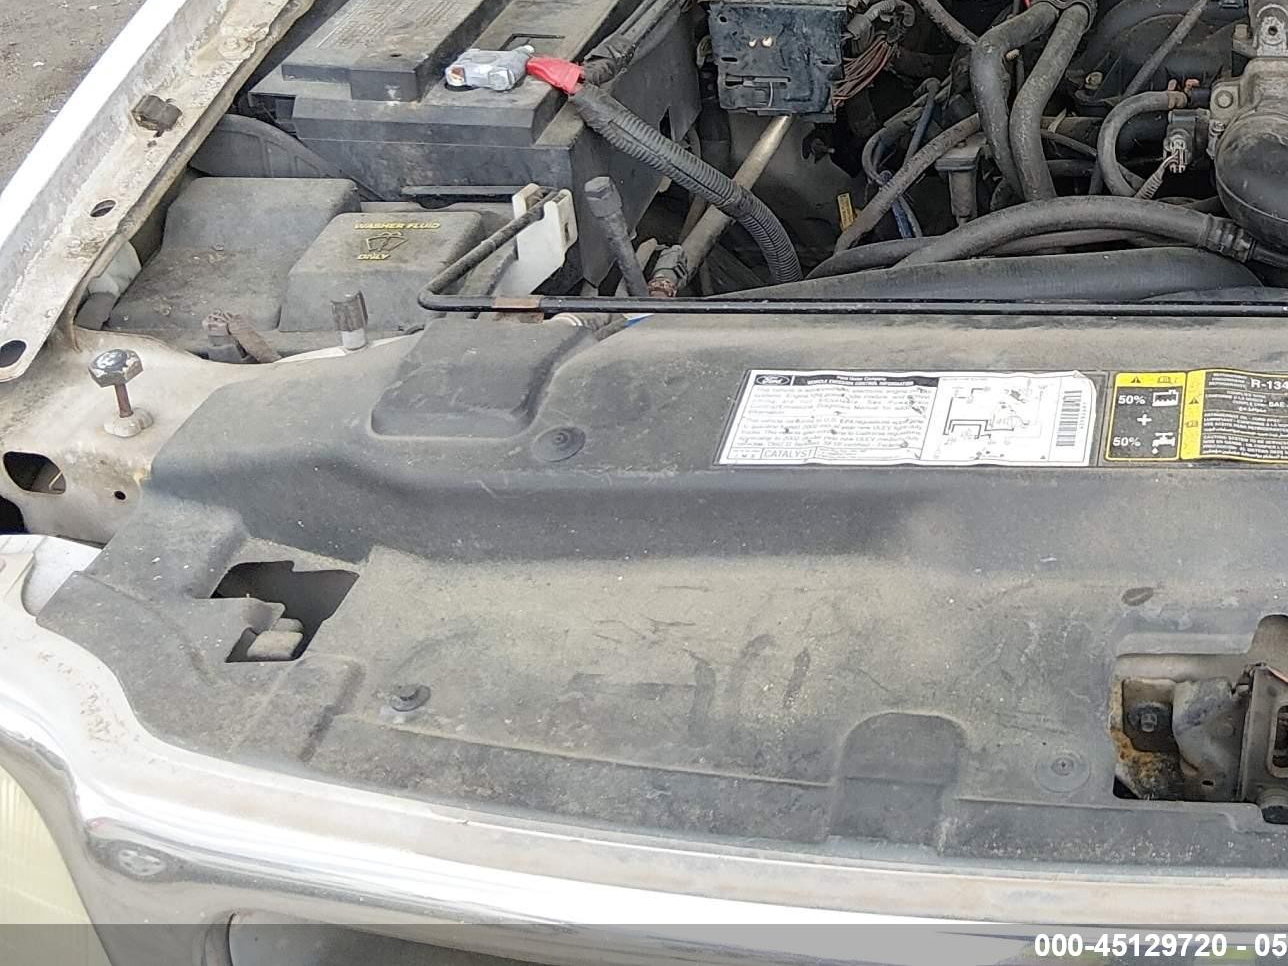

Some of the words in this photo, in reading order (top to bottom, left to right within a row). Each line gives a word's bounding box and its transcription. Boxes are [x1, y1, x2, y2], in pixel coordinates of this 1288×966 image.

[357, 252, 390, 260] ONLY
[1118, 394, 1146, 405] 50%
[1113, 436, 1141, 447] 50%
[764, 448, 813, 458] CATALYST
